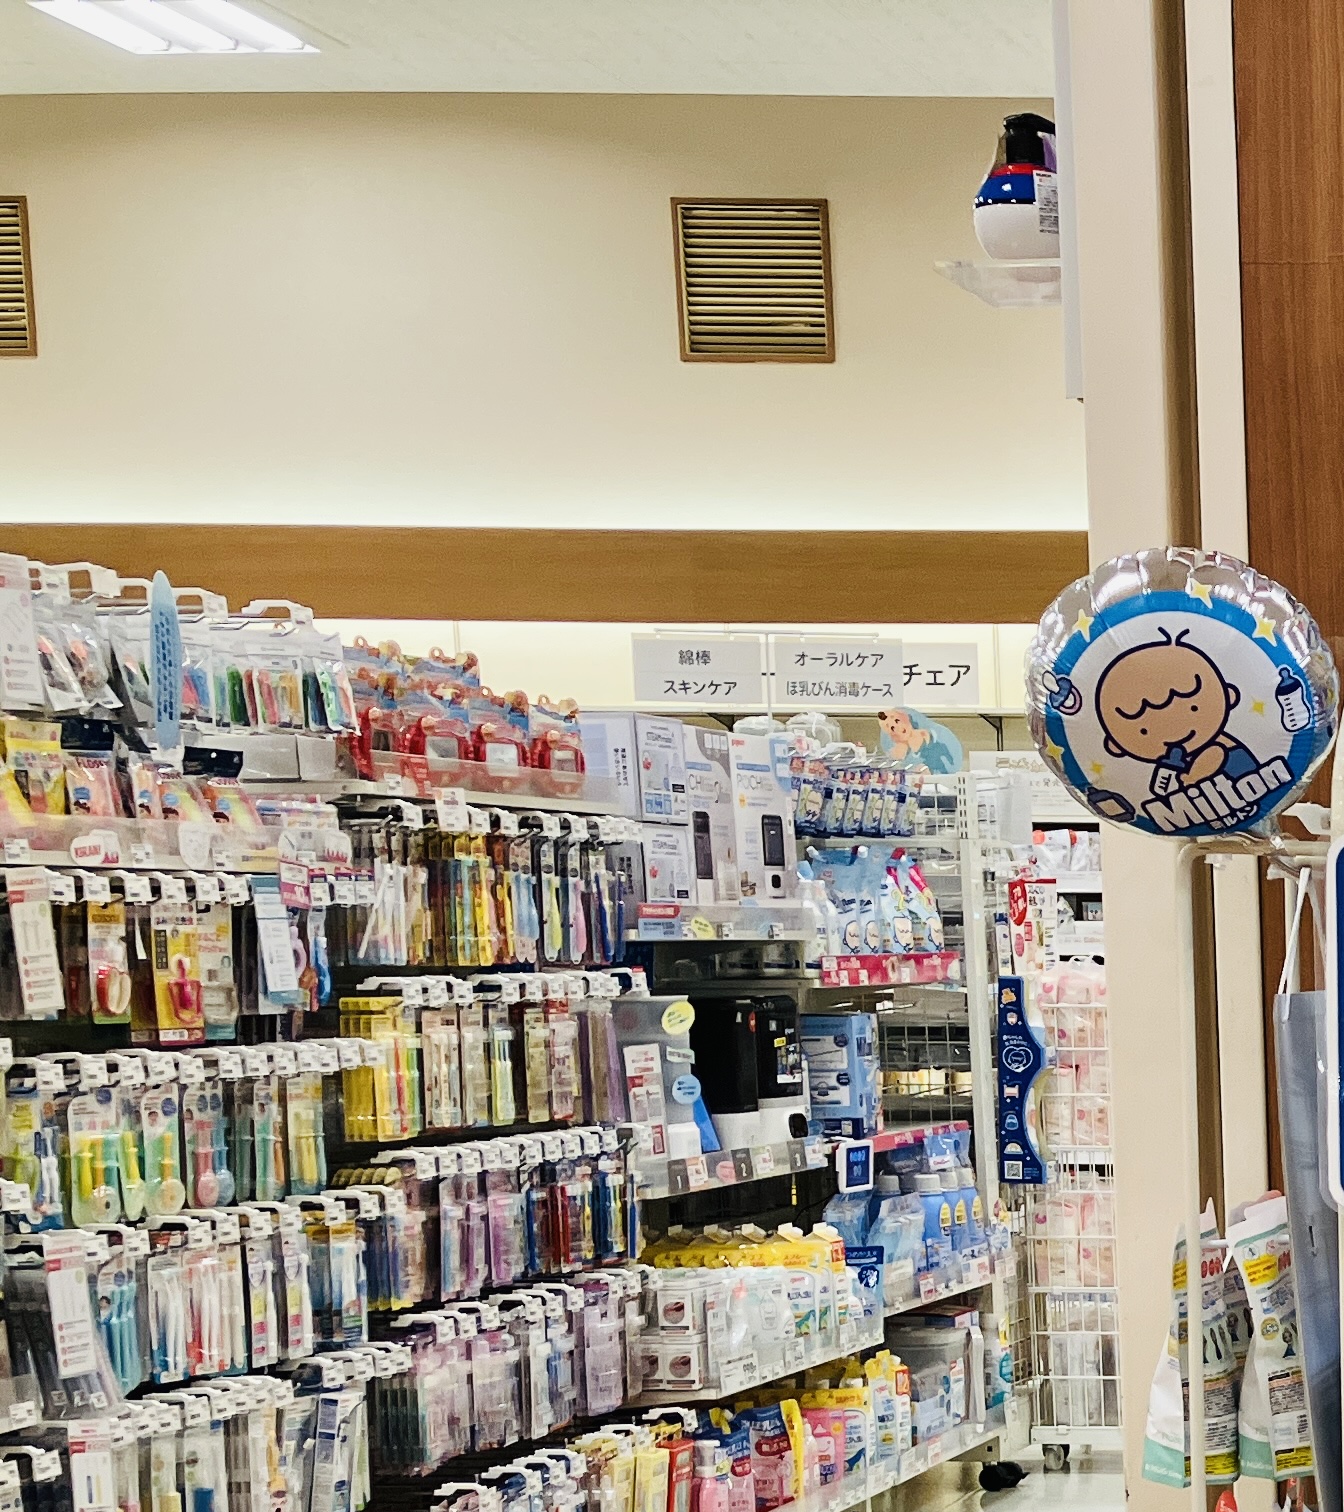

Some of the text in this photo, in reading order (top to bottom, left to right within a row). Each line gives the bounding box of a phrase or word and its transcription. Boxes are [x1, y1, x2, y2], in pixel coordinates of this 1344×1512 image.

[677, 649, 712, 667] 綿棒
[794, 652, 884, 668] オーラルケア
[902, 663, 971, 688] チェア
[663, 678, 738, 697] スキンケア
[786, 680, 893, 699] ほ乳びん消毒ケース
[1141, 757, 1292, 833] Milton
